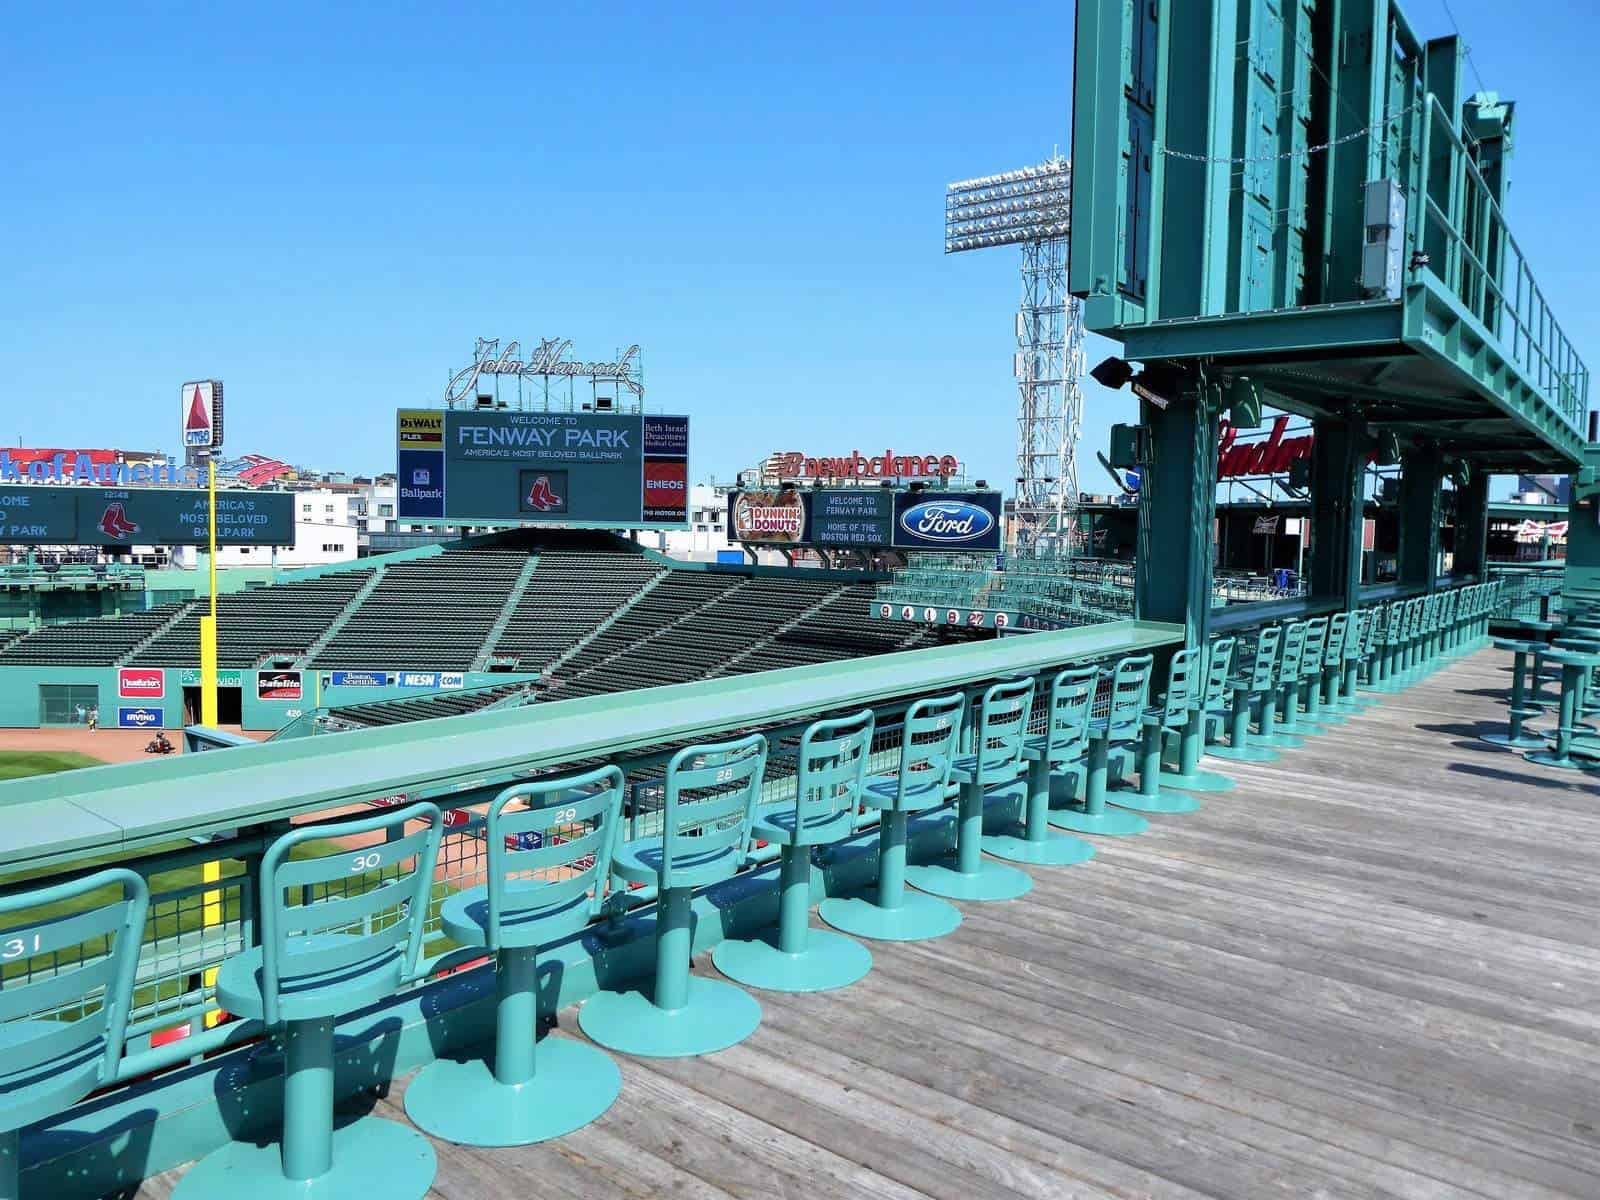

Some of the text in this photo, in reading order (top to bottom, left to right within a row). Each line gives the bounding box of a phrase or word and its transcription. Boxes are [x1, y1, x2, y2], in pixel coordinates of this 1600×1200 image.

[445, 336, 645, 402] John Hancock
[511, 415, 577, 425] WELCOME TO
[458, 426, 630, 449] FENWAY PARK
[464, 448, 508, 457] AMERICA'S
[538, 450, 576, 459] BELOVED
[579, 451, 623, 459] BALLPARK
[646, 480, 684, 489] ENEOS
[401, 487, 443, 500] Ballpark
[829, 496, 875, 505] WELCOME TO
[826, 506, 877, 516] FENWAY PARK
[216, 514, 268, 524] BELOVED
[918, 506, 975, 534] Ford
[11, 525, 48, 536] PARK
[754, 519, 797, 531] DONUTS
[827, 523, 877, 532] HOME OF THE
[194, 527, 255, 538] BALPARK
[821, 533, 882, 542] BOSTON RED SOX
[259, 679, 300, 688] Safelite
[126, 713, 156, 722] IRVING
[554, 807, 577, 824] 29
[351, 852, 381, 871] 30
[2, 934, 40, 959] 31
